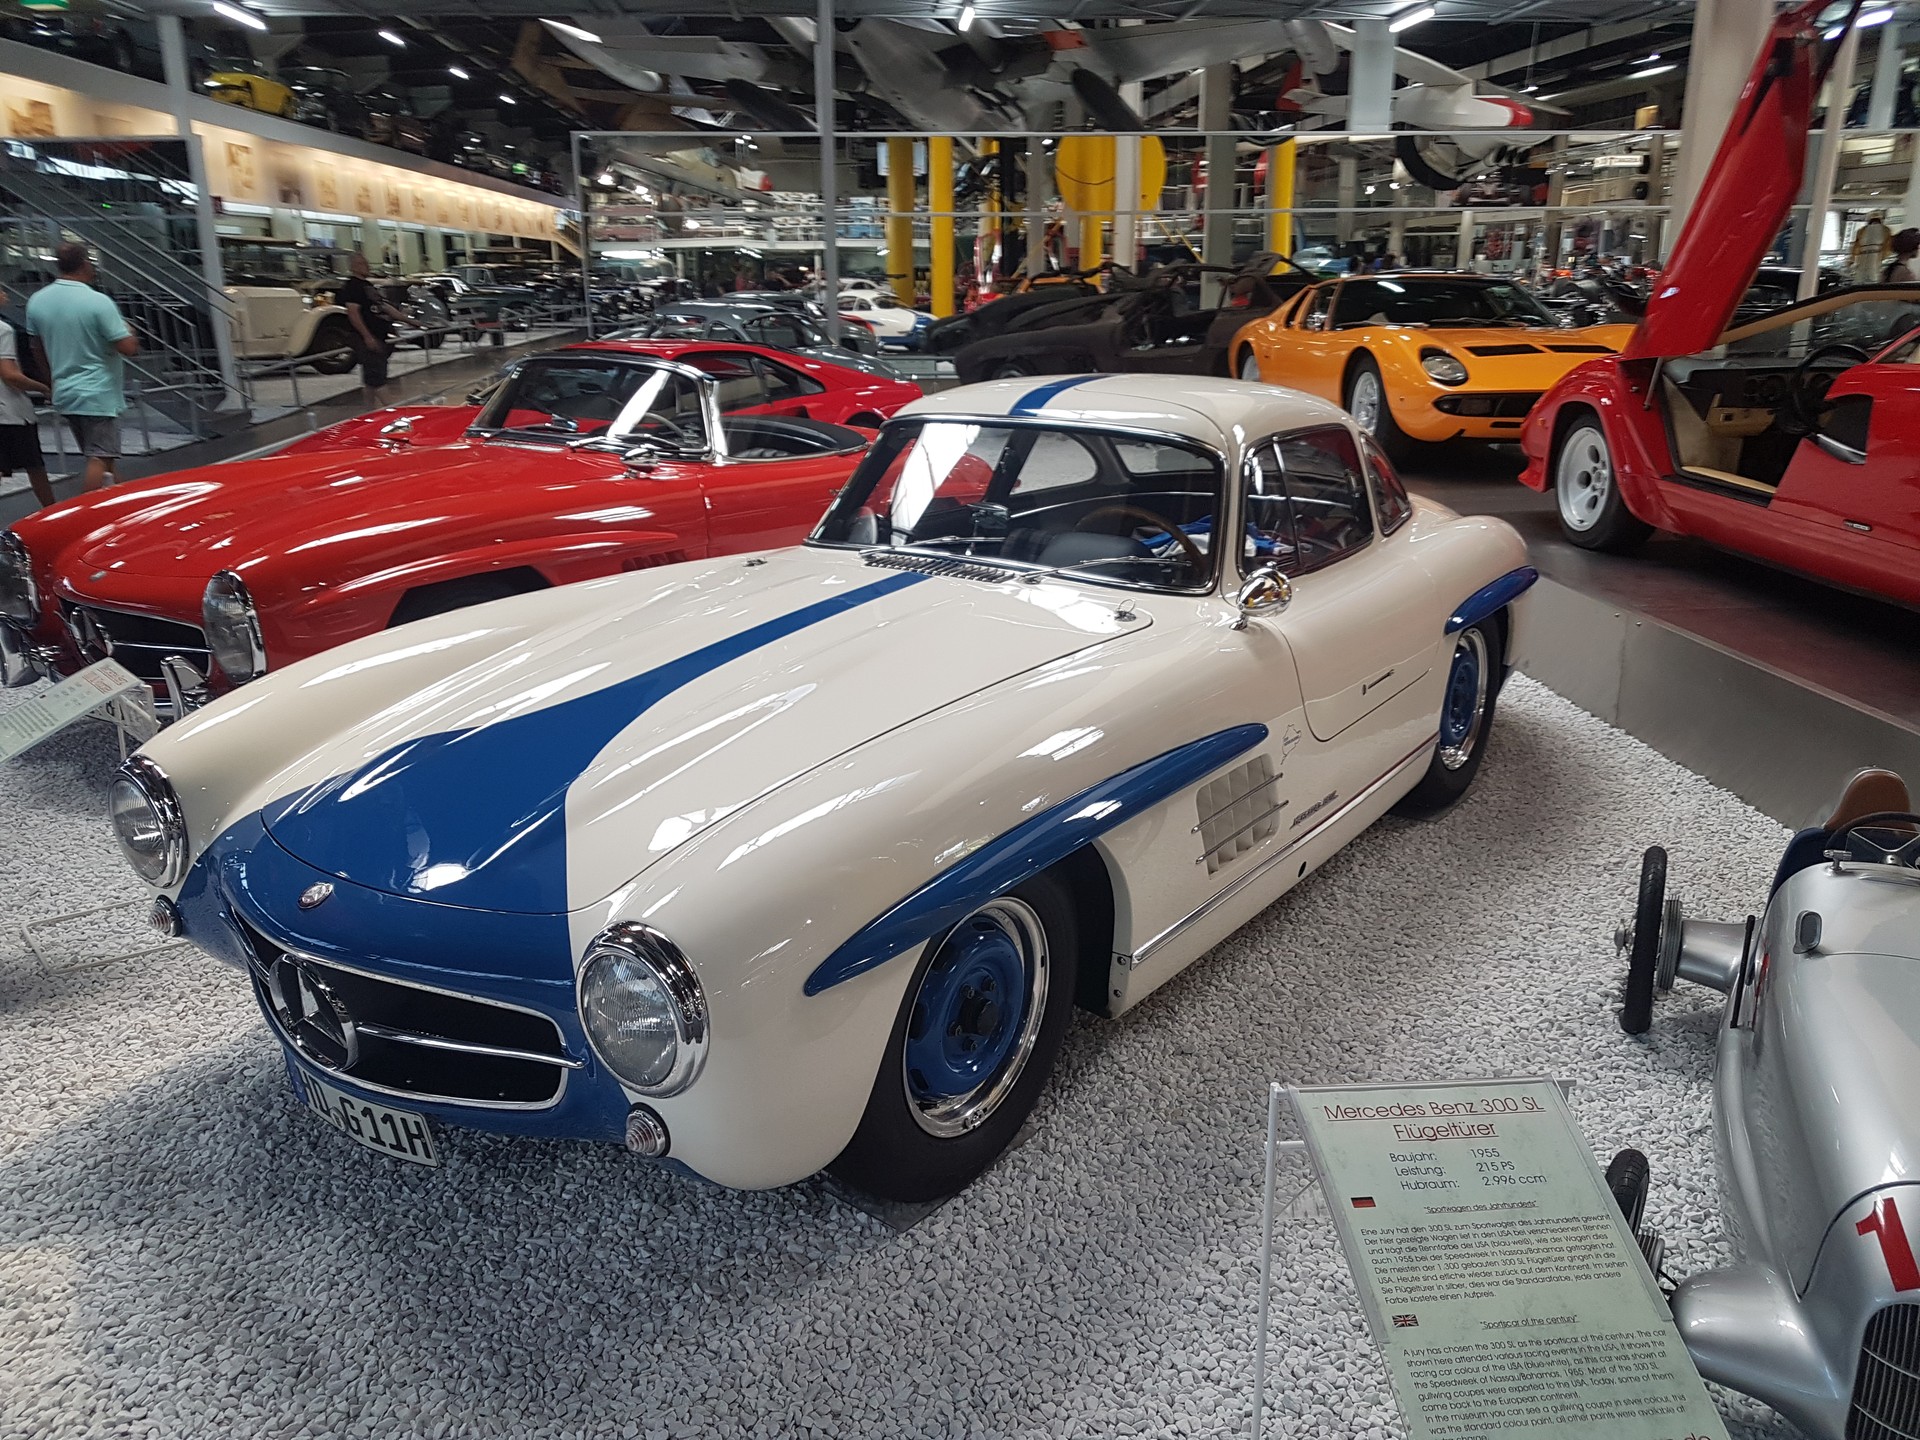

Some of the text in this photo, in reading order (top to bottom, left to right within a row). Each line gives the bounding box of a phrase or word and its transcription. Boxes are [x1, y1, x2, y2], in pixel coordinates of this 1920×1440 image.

[1324, 1096, 1544, 1120] Mercedes Benz 300 SL
[339, 1096, 432, 1159] G11H
[1393, 1121, 1496, 1141] Flügeltürer
[1389, 1148, 1500, 1164] Baujahr: 1955
[1394, 1161, 1515, 1177] Leistung: 215 PS
[1400, 1174, 1548, 1191] Hubraum: 2.996 ccm
[1395, 1236, 1429, 1245] gezeigte
[1430, 1234, 1459, 1242] Wagen
[1526, 1226, 1582, 1235] verschiedenen
[1582, 1224, 1612, 1232] Rennen
[1428, 1224, 1444, 1232] 300
[1471, 1221, 1517, 1231] Sportwagen
[1534, 1216, 1581, 1225] Jahrhunderts
[1368, 1247, 1384, 1255] und
[1418, 1243, 1459, 1252] Rennfarbe
[1563, 1234, 1591, 1243] Wagen
[1371, 1257, 1393, 1265] auch
[1394, 1255, 1414, 1263] 1955
[1444, 1251, 1490, 1261] Speedweek
[1565, 1244, 1601, 1253] getragen
[1856, 1197, 1920, 1292] 1
[1374, 1267, 1388, 1275] Die
[1389, 1265, 1421, 1273] meisten
[1461, 1260, 1500, 1271] gebauten
[1500, 1258, 1516, 1266] 300
[1566, 1253, 1594, 1263] gingen
[1396, 1275, 1421, 1283] Heute
[1421, 1274, 1438, 1282] sind
[1467, 1270, 1493, 1278] wieder
[1494, 1268, 1519, 1277] zurück
[1593, 1271, 1621, 1279] andere
[1409, 1294, 1438, 1303] kostete
[1439, 1293, 1462, 1301] einen
[1403, 1349, 1410, 1357] A
[1411, 1349, 1425, 1357] jury
[1443, 1345, 1474, 1354] chosen
[1490, 1341, 1506, 1350] 300
[1506, 1340, 1516, 1349] SL
[1543, 1337, 1579, 1346] sportscar
[1636, 1330, 1652, 1338] The
[1406, 1359, 1433, 1367] shown
[1455, 1353, 1493, 1363] attended
[1493, 1352, 1523, 1360] various
[1523, 1350, 1551, 1358] racing
[1551, 1347, 1578, 1355] events
[1626, 1342, 1651, 1350] shows
[1410, 1370, 1438, 1379] racing
[1454, 1366, 1480, 1375] colour
[1506, 1362, 1524, 1370] USA
[1584, 1356, 1598, 1364] this
[1631, 1352, 1657, 1360] shown
[1429, 1377, 1479, 1389] Speedweek
[1587, 1366, 1607, 1375] Most
[1633, 1362, 1649, 1371] 300
[1649, 1361, 1659, 1370] SL
[1418, 1391, 1452, 1402] gullwing
[1453, 1389, 1485, 1398] coupes
[1508, 1383, 1545, 1394] exported
[1617, 1376, 1641, 1384] some
[1651, 1372, 1675, 1380] them
[1421, 1403, 1448, 1412] came
[1449, 1400, 1472, 1409] back
[1498, 1395, 1540, 1405] European
[1425, 1415, 1434, 1423] In
[1451, 1412, 1489, 1421] museum
[1489, 1411, 1506, 1419] you
[1507, 1408, 1525, 1416] can
[1525, 1407, 1541, 1415] see
[1551, 1403, 1585, 1414] gullwing
[1585, 1401, 1613, 1410] coupe
[1623, 1398, 1643, 1406] silver
[1429, 1427, 1447, 1435] was
[1447, 1425, 1462, 1433] the
[1464, 1420, 1502, 1432] standard
[1503, 1419, 1529, 1429] colour
[1567, 1414, 1589, 1422] other
[1590, 1411, 1616, 1421] paints
[1638, 1407, 1675, 1416] available
